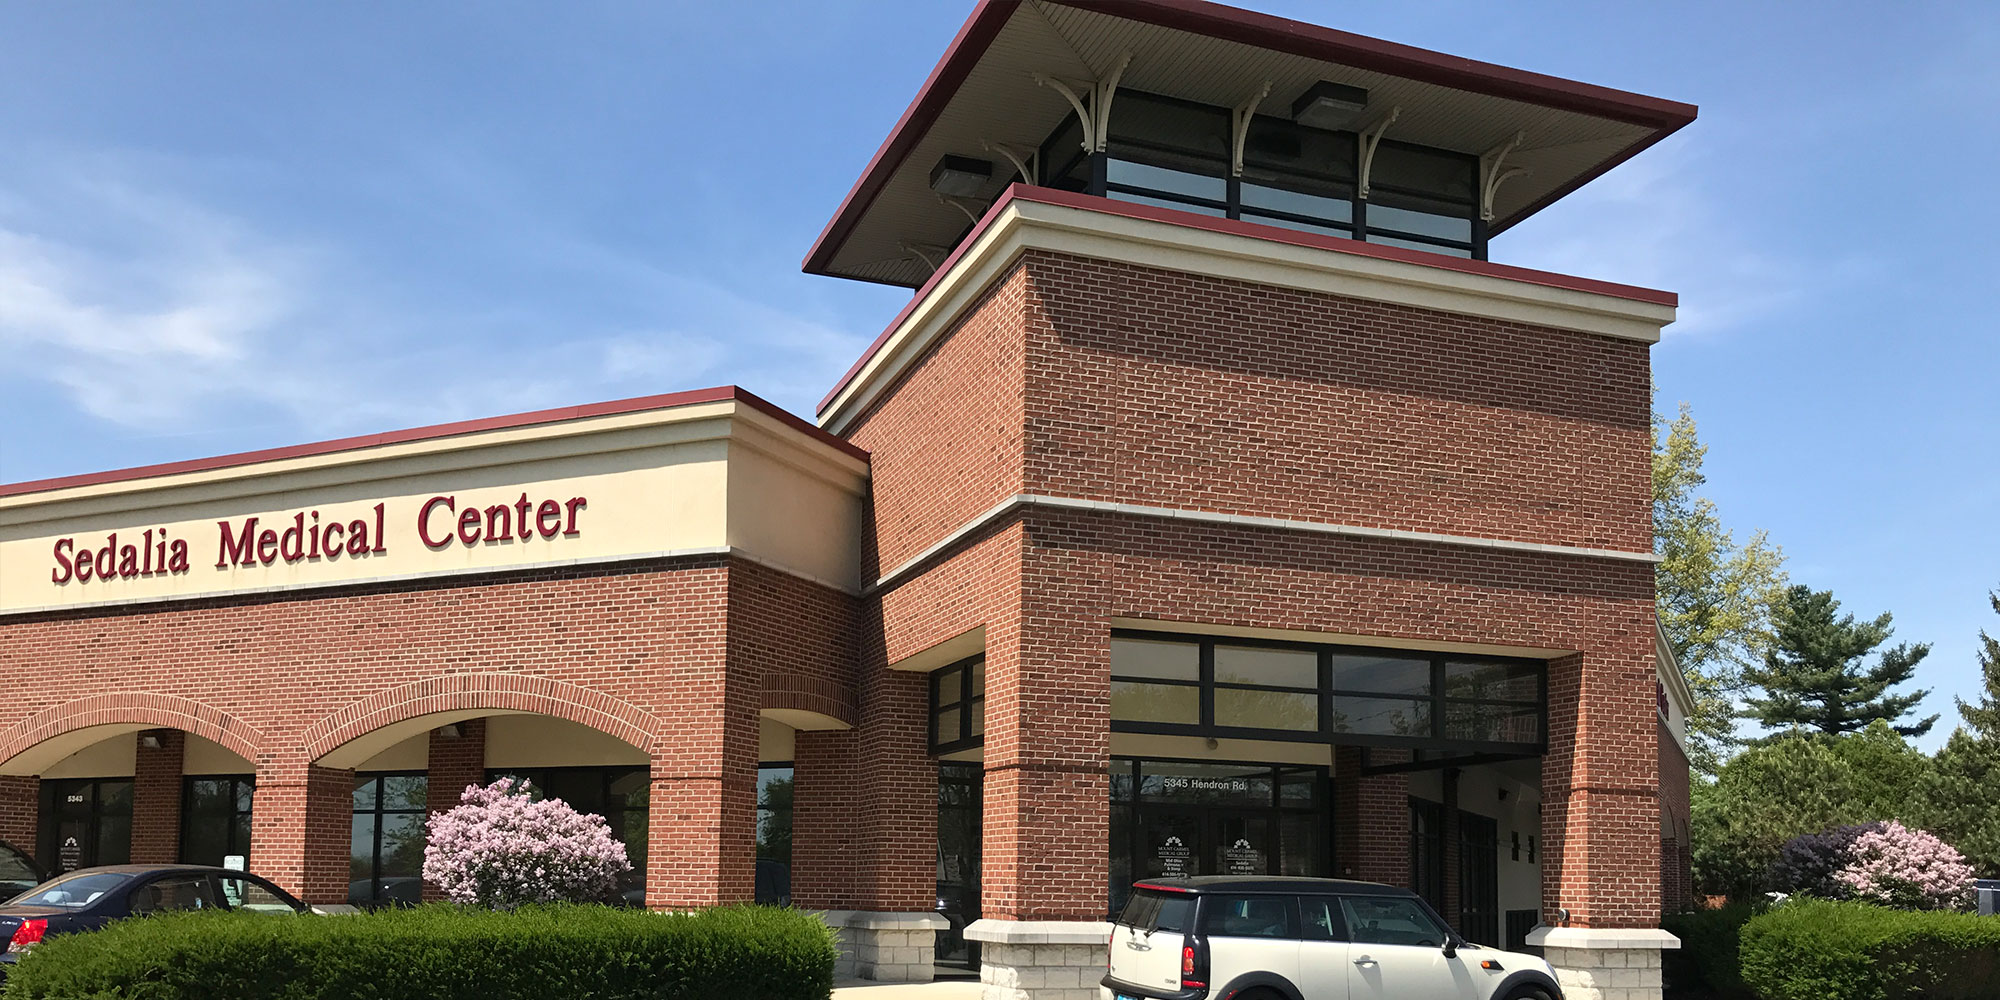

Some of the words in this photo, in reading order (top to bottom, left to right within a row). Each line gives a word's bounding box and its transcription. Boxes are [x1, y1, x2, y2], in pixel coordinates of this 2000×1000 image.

[52, 527, 190, 585] Sedalia
[215, 502, 388, 569] Medical
[418, 492, 587, 549] Center
[1163, 778, 1188, 788] 5345
[1191, 779, 1229, 789] Hendron
[1232, 780, 1247, 791] Rd.
